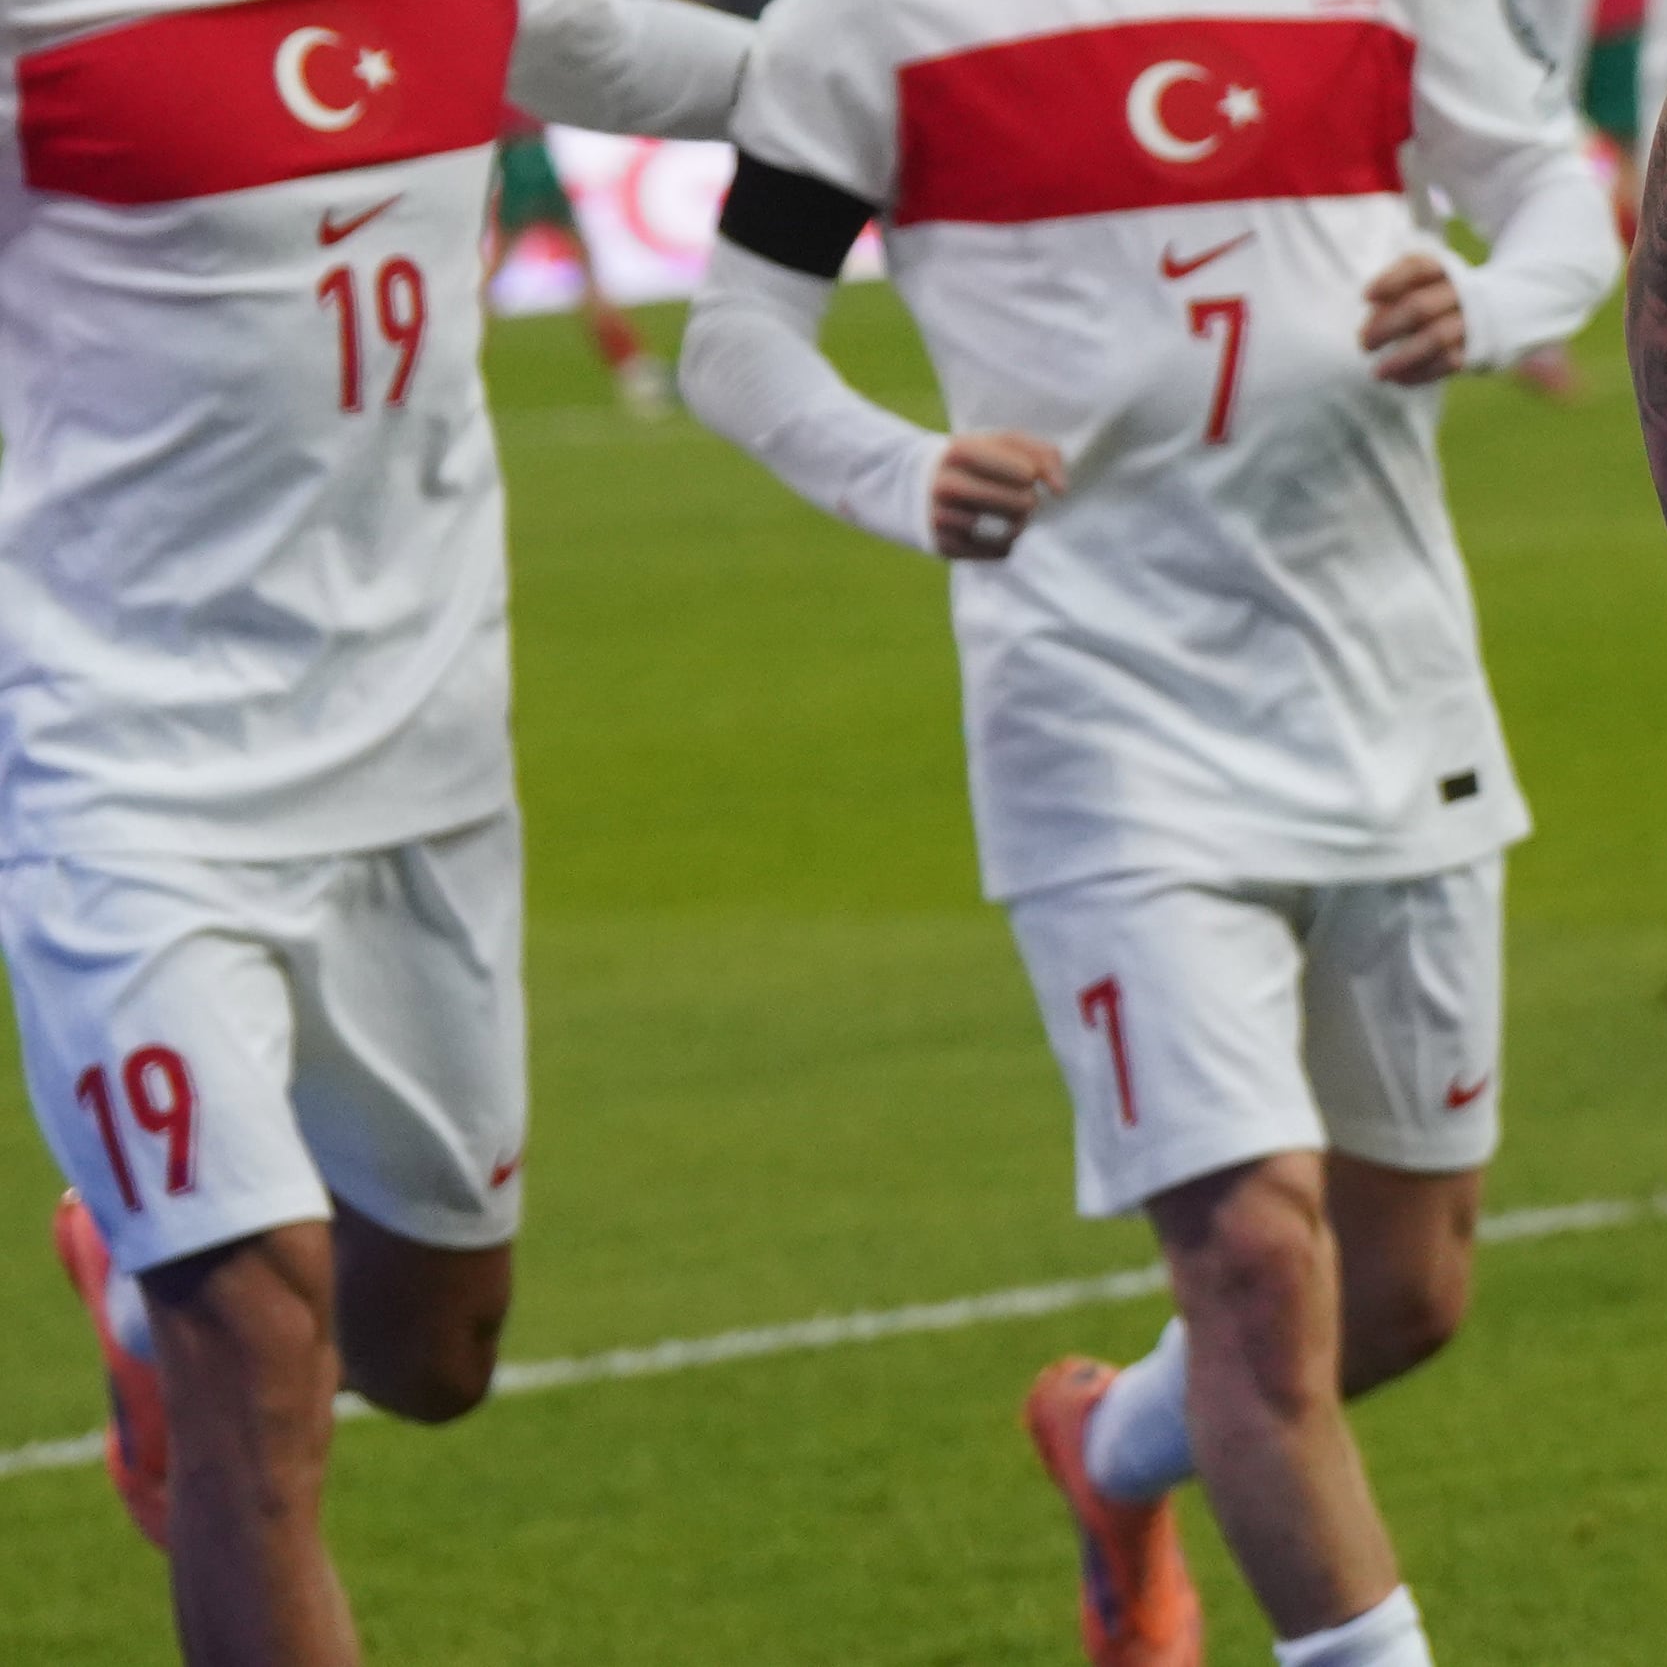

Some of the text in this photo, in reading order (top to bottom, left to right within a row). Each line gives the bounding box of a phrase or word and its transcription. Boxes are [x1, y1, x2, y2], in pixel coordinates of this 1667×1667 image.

[317, 256, 428, 415] 19
[1188, 297, 1247, 447] 7
[76, 1043, 197, 1213] 19
[1077, 974, 1139, 1129] 7
